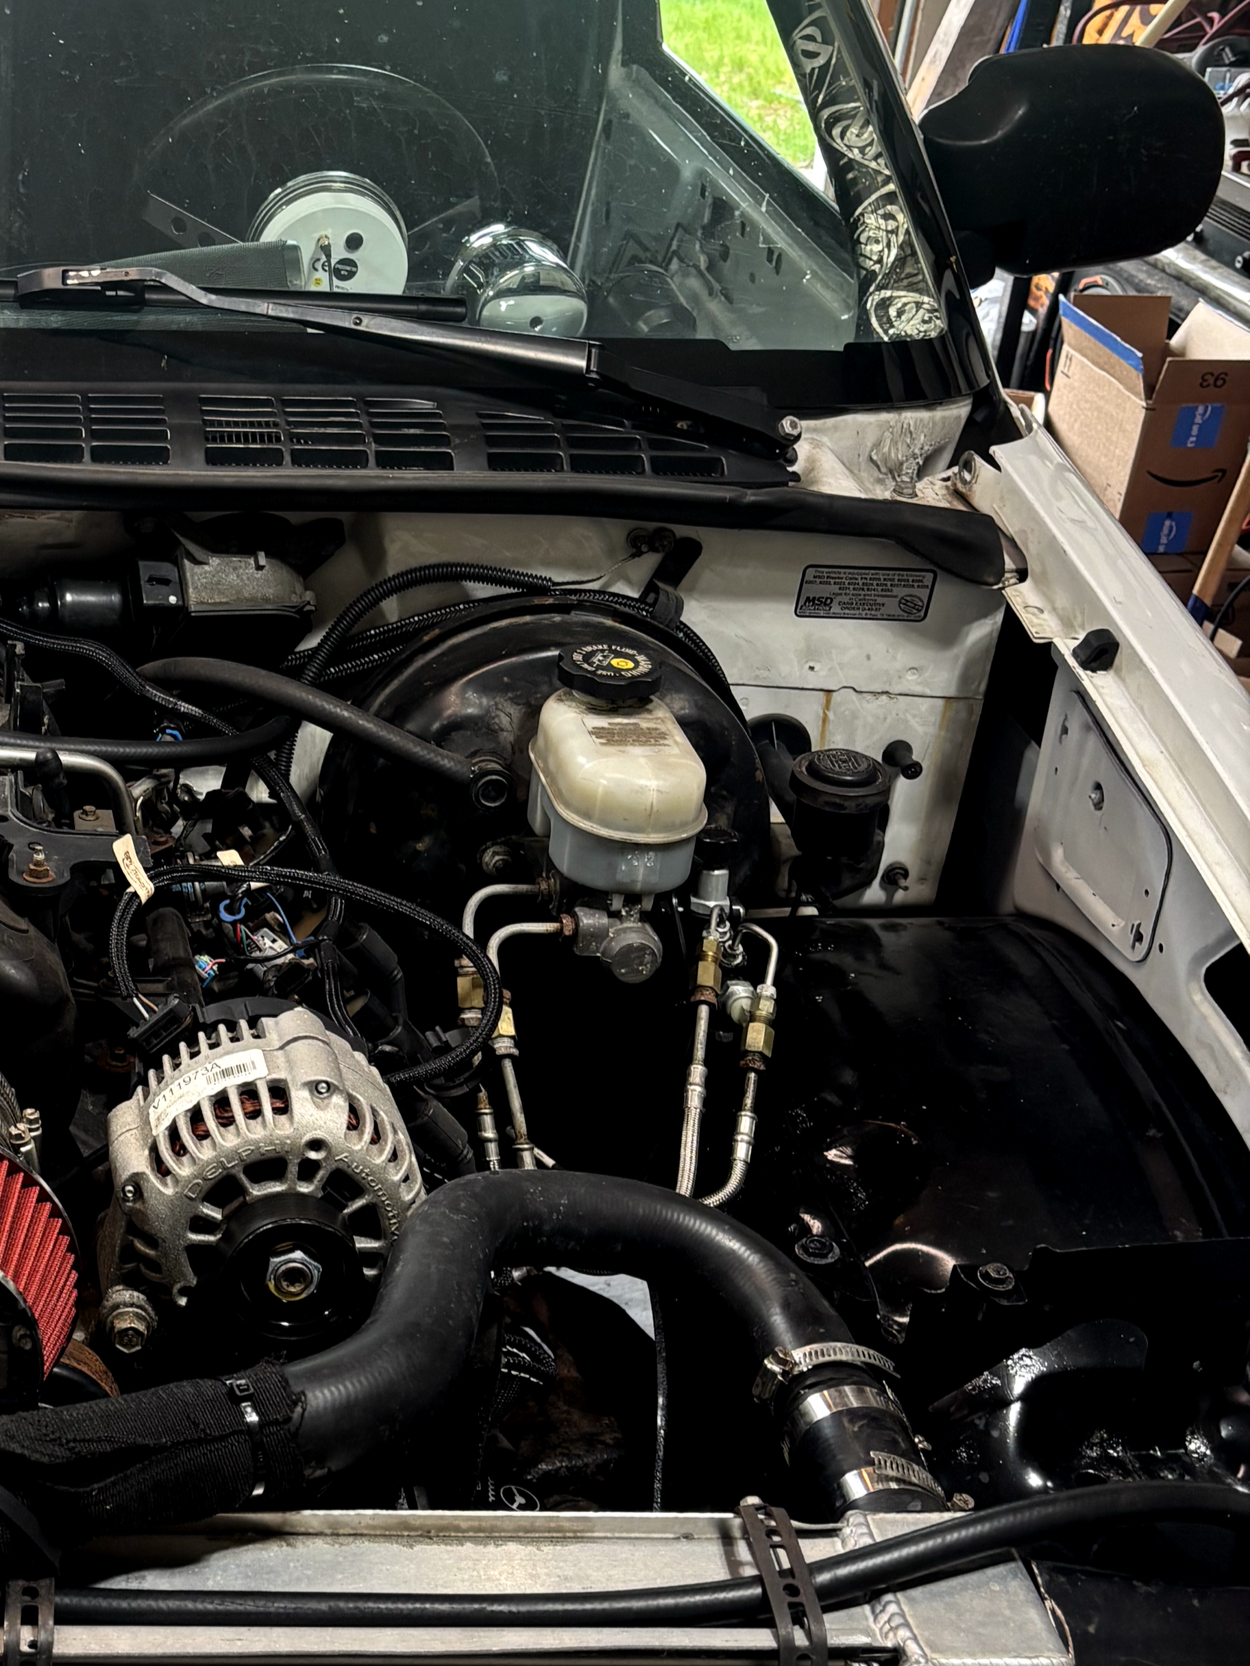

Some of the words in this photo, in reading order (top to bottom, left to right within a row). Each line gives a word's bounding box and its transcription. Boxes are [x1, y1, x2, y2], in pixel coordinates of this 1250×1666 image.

[1199, 371, 1228, 389] 93
[803, 596, 834, 606] MSD
[152, 1061, 222, 1110] V111973A
[184, 1139, 292, 1200] DELPHI
